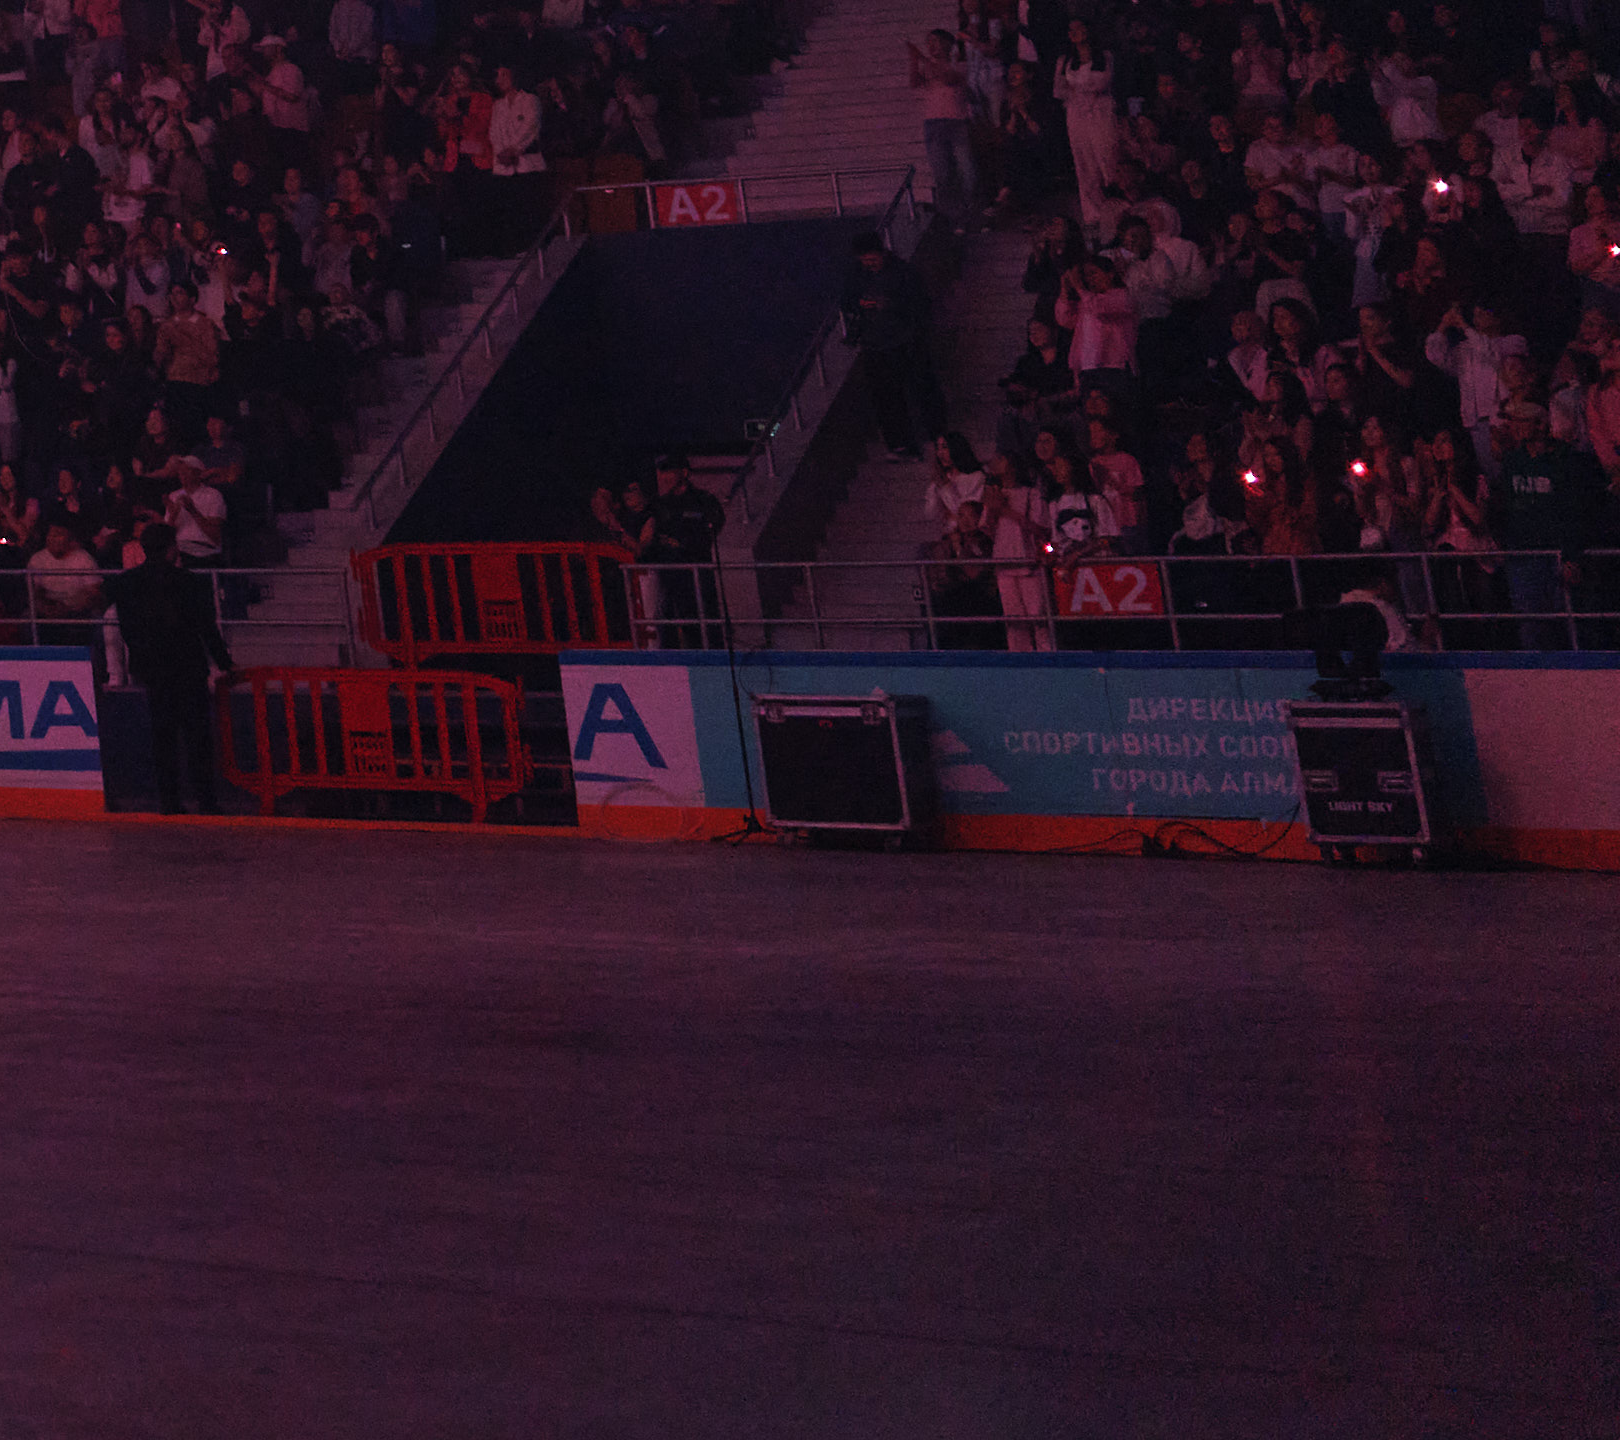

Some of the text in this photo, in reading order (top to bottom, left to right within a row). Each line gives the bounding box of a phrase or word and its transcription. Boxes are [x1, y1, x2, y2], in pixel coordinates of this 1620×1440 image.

[667, 186, 732, 223] A2
[1069, 565, 1155, 615] A2
[574, 683, 668, 769] A
[1091, 768, 1212, 798] ГОРОДА
[1328, 800, 1363, 812] LIGHT
